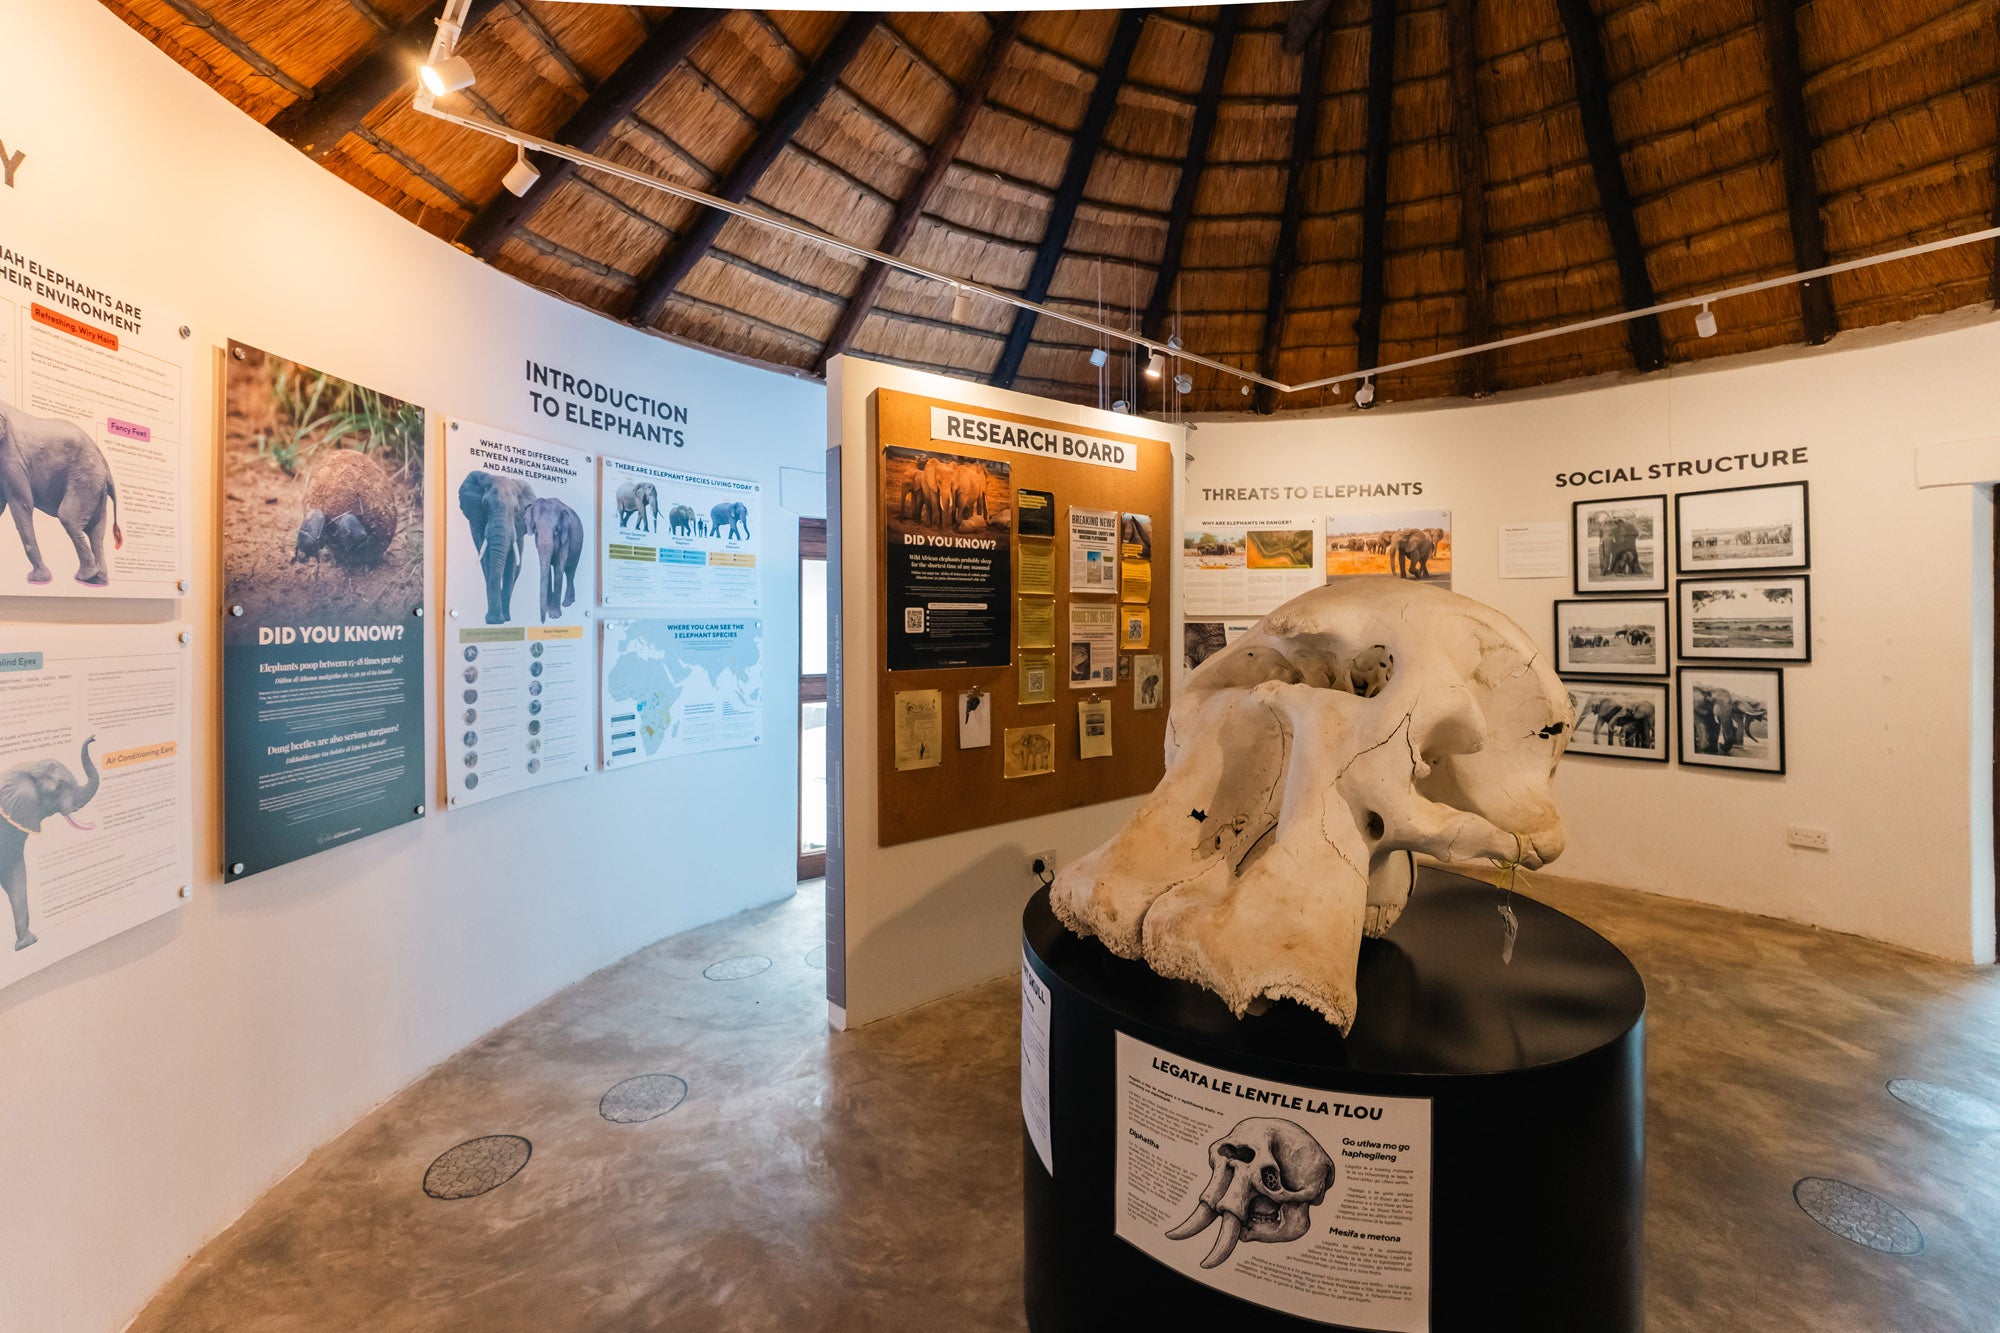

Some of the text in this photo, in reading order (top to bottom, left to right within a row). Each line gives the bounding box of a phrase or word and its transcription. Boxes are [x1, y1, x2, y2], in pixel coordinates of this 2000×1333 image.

[29, 259, 113, 308] ELEPHANTS
[115, 300, 142, 320] ARE
[36, 281, 142, 335] ENVIRONMENT
[79, 325, 96, 341] Wiry
[97, 333, 116, 347] Hairs
[526, 360, 688, 425] INTRODUCTION
[110, 421, 147, 438] Fancy Feet
[529, 391, 684, 448] TO ELEPHANTS
[947, 415, 1125, 464] RESEARCH BOARD
[470, 447, 577, 477] BETWEEN AFRICAN SAVANNAH
[480, 438, 569, 466] WHAT IS THE DIFFERENCE
[483, 461, 568, 484] AND ASIAN ELEPHANTS?
[614, 462, 635, 472] THERE
[635, 467, 648, 475] ARE
[653, 470, 684, 481] ELEPHANT
[685, 475, 710, 485] SPECIES
[710, 479, 732, 488] LIVING
[732, 482, 752, 490] TODAY
[1555, 446, 1809, 488] SOCIAL STRUCTURE
[1202, 481, 1423, 501] THREATS TO ELEPHANTS
[1072, 514, 1115, 528] BREAKING NEWS
[904, 533, 997, 550] DID YOU KNOW?
[258, 624, 405, 646] DID YOU KNOW?
[18, 657, 37, 668] Eyes
[259, 662, 299, 674] Elephants
[299, 662, 319, 672] poop
[319, 659, 348, 668] between
[363, 656, 381, 665] times
[380, 657, 392, 666] per
[267, 743, 290, 756] Dung
[290, 739, 317, 751] beetles
[317, 738, 329, 746] are
[329, 735, 344, 744] also
[344, 731, 367, 741] serious
[106, 746, 174, 766] Air Conditioning Ears
[1028, 973, 1046, 1005] SKULL
[1152, 1056, 1208, 1088] LEGATA
[1211, 1078, 1233, 1095] LE
[1235, 1084, 1304, 1110] LENTLE
[1306, 1099, 1329, 1115] LA
[1333, 1103, 1384, 1121] TLOU
[1342, 1137, 1356, 1146] Go
[1357, 1140, 1382, 1149] utlwa
[1398, 1144, 1410, 1152] go
[1342, 1148, 1397, 1163] haphegileng
[1329, 1226, 1359, 1239] Mesifa
[1367, 1233, 1402, 1243] metona
